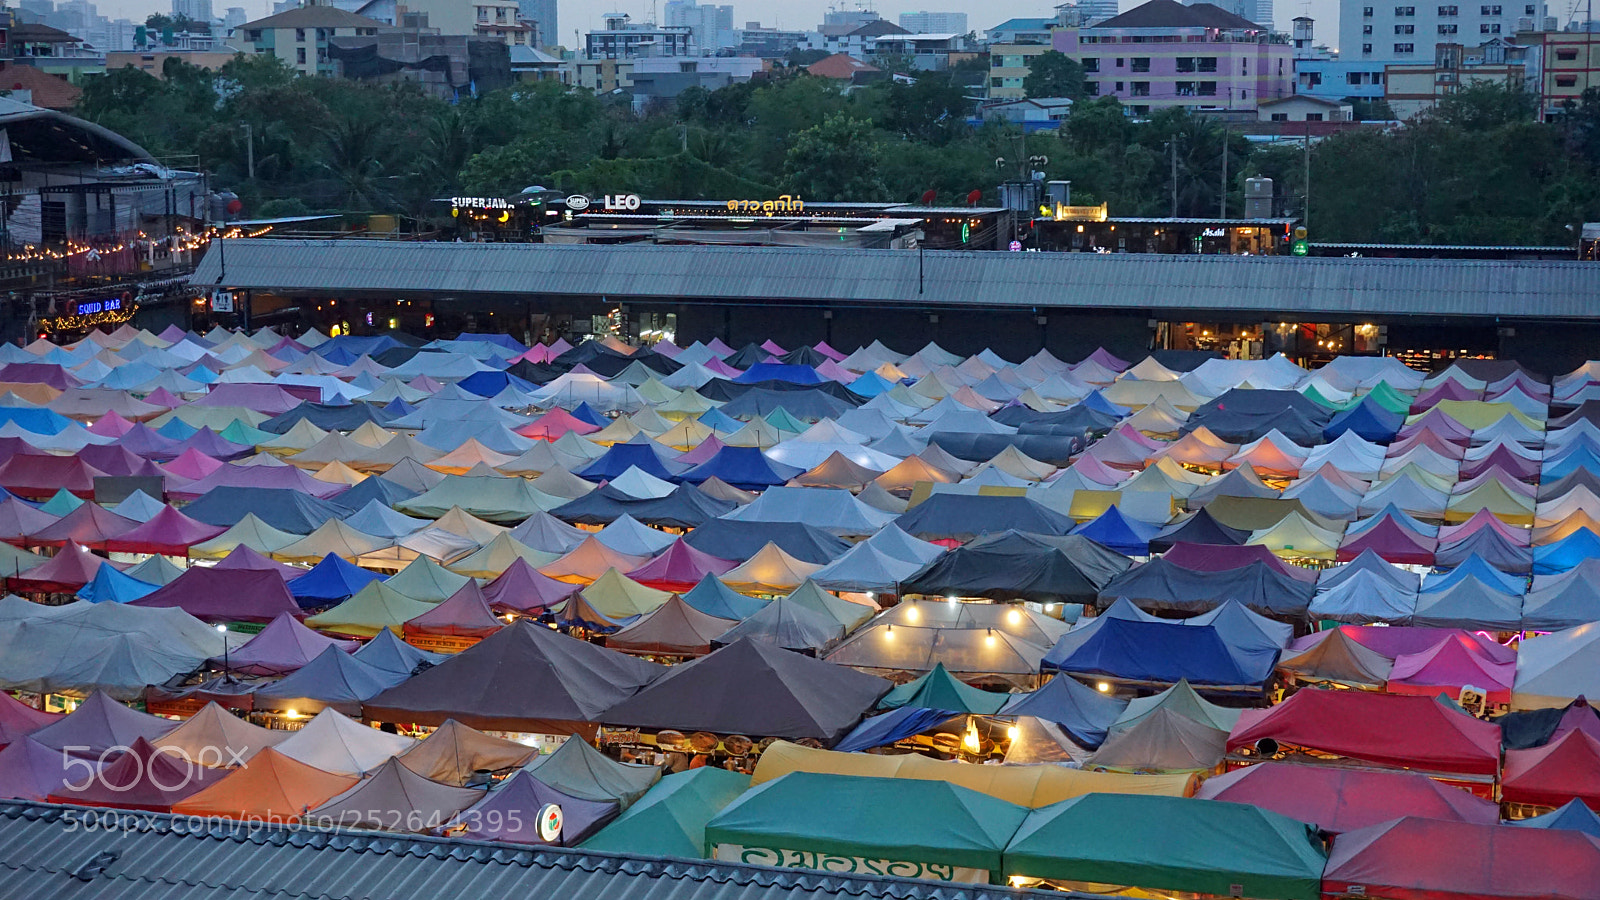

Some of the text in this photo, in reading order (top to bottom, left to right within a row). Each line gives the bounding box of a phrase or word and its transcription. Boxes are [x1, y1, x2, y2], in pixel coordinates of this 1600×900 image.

[604, 194, 641, 211] LEO
[1202, 227, 1225, 237] Asahi
[78, 299, 121, 315] SQUID BAR
